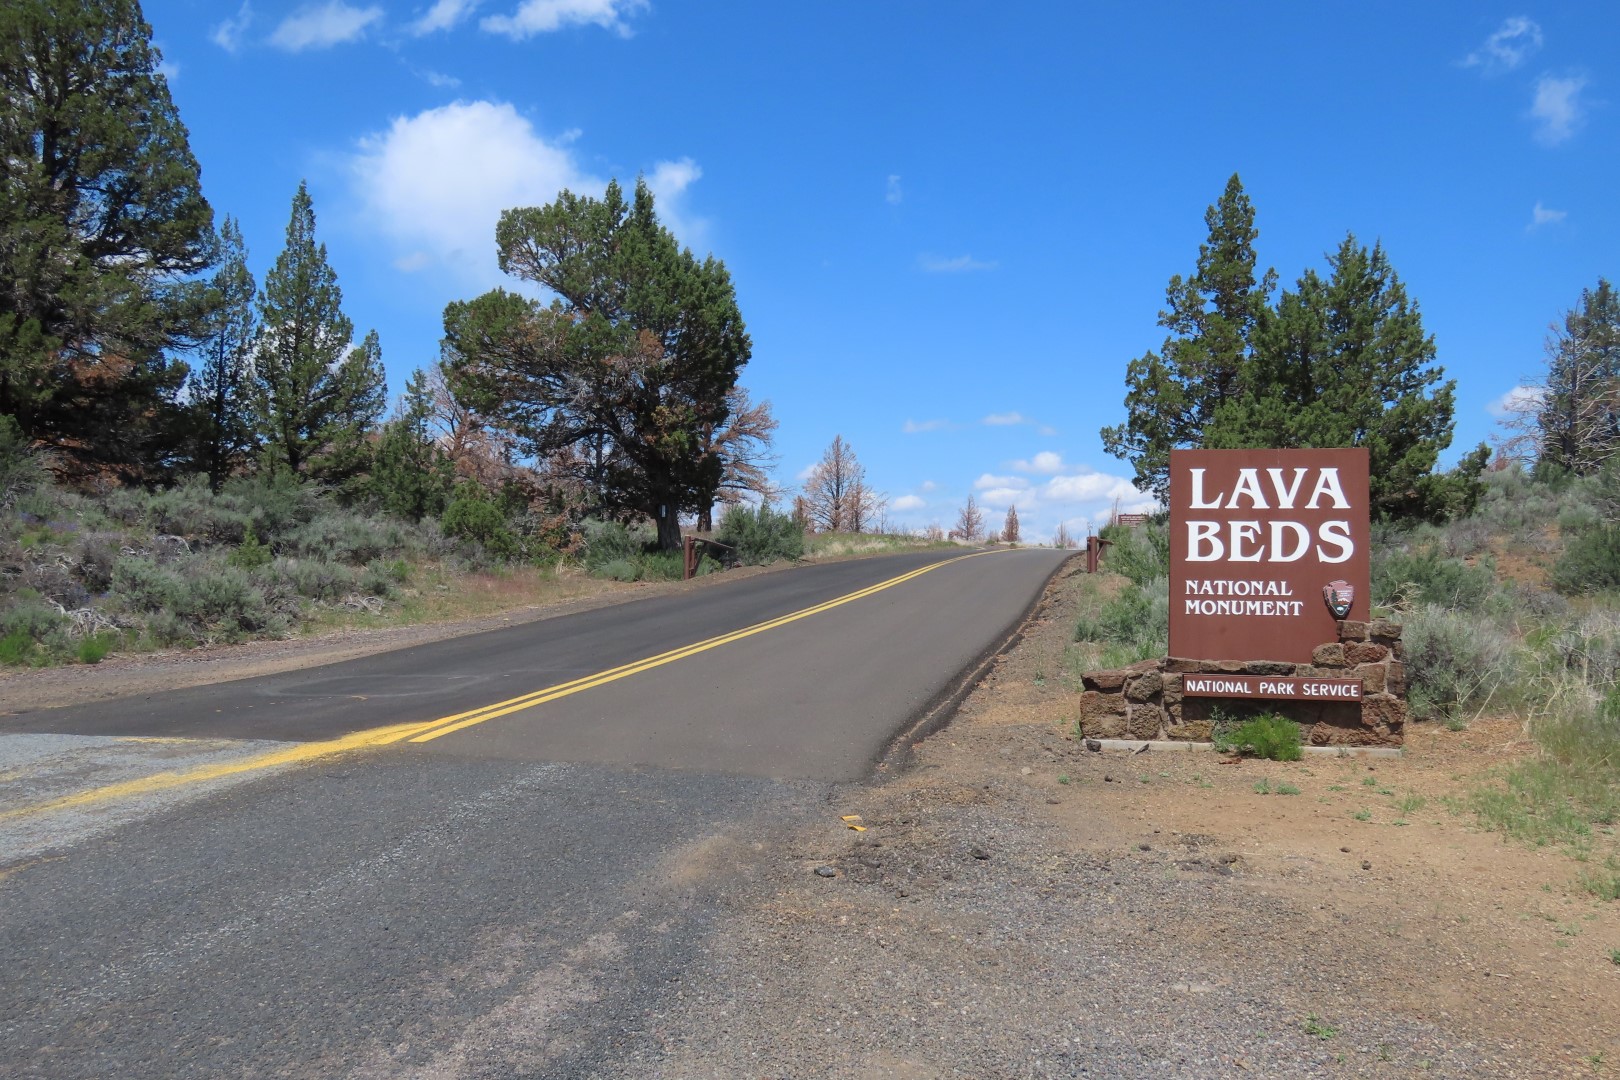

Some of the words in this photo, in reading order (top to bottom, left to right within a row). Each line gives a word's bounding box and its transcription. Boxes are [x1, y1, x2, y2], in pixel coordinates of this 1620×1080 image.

[1188, 467, 1352, 510] LAVA
[1184, 520, 1355, 564] BEDS
[1185, 579, 1293, 596] NATIONAL
[1184, 599, 1304, 616] MONUMENT
[1186, 679, 1252, 694] NATIONAL
[1259, 681, 1295, 696] PARK
[1302, 683, 1359, 698] SERVICE
